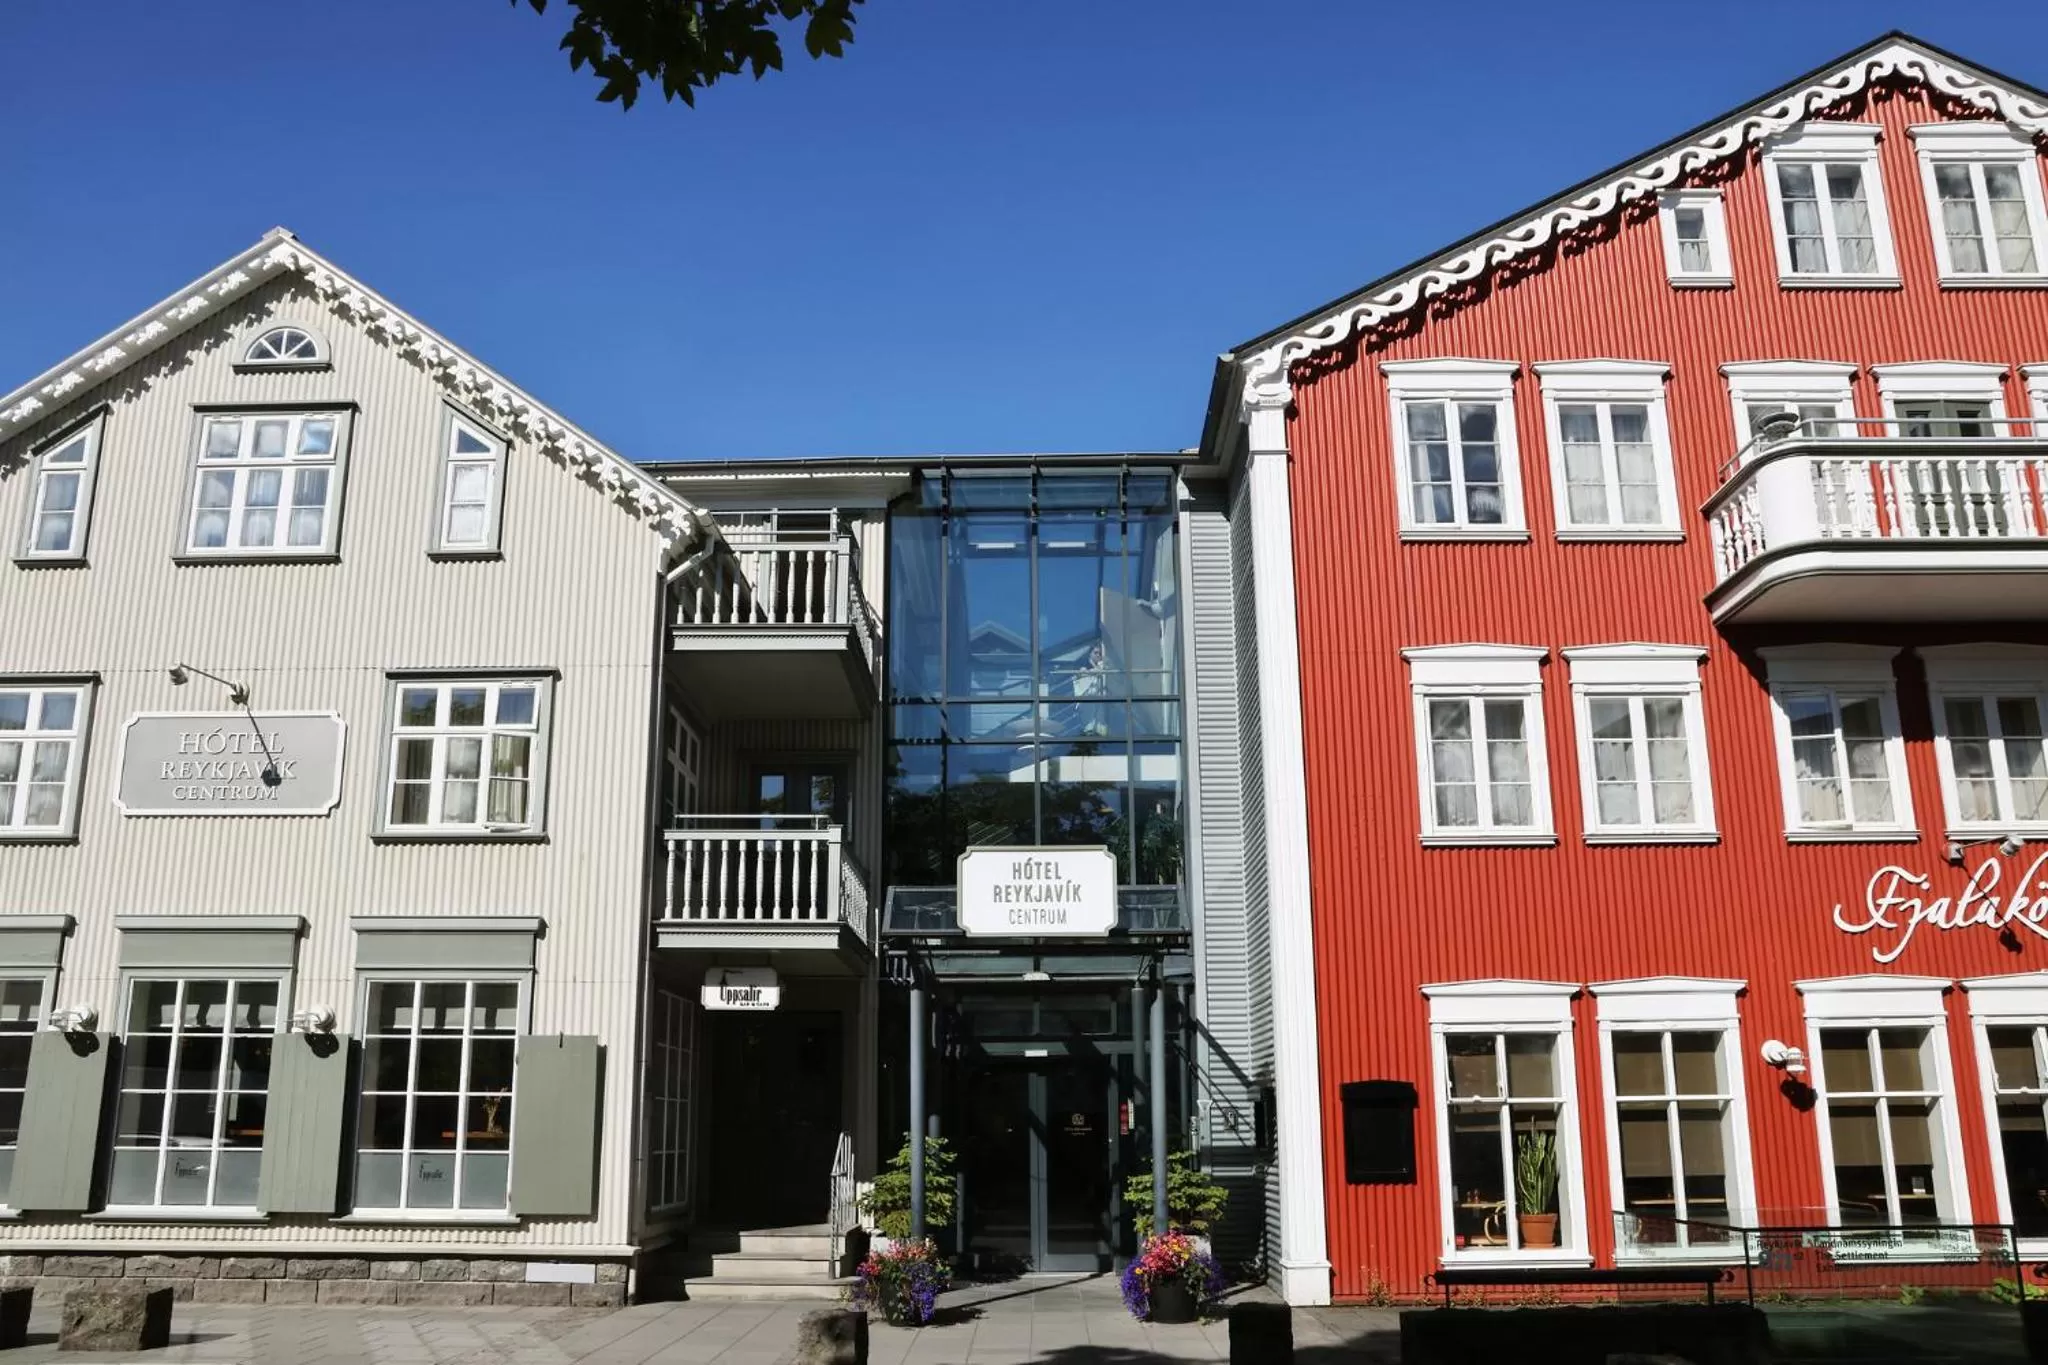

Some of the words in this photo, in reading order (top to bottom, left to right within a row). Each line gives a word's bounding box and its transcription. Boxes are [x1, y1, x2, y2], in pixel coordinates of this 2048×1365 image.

[178, 727, 285, 754] HÓTEL
[171, 784, 278, 801] CENTRUM
[1012, 857, 1062, 880] HÓTEL
[993, 880, 1082, 903] REYKJAVÍK
[1008, 908, 1067, 925] CENTRUM
[719, 984, 762, 1005] Uppsalir
